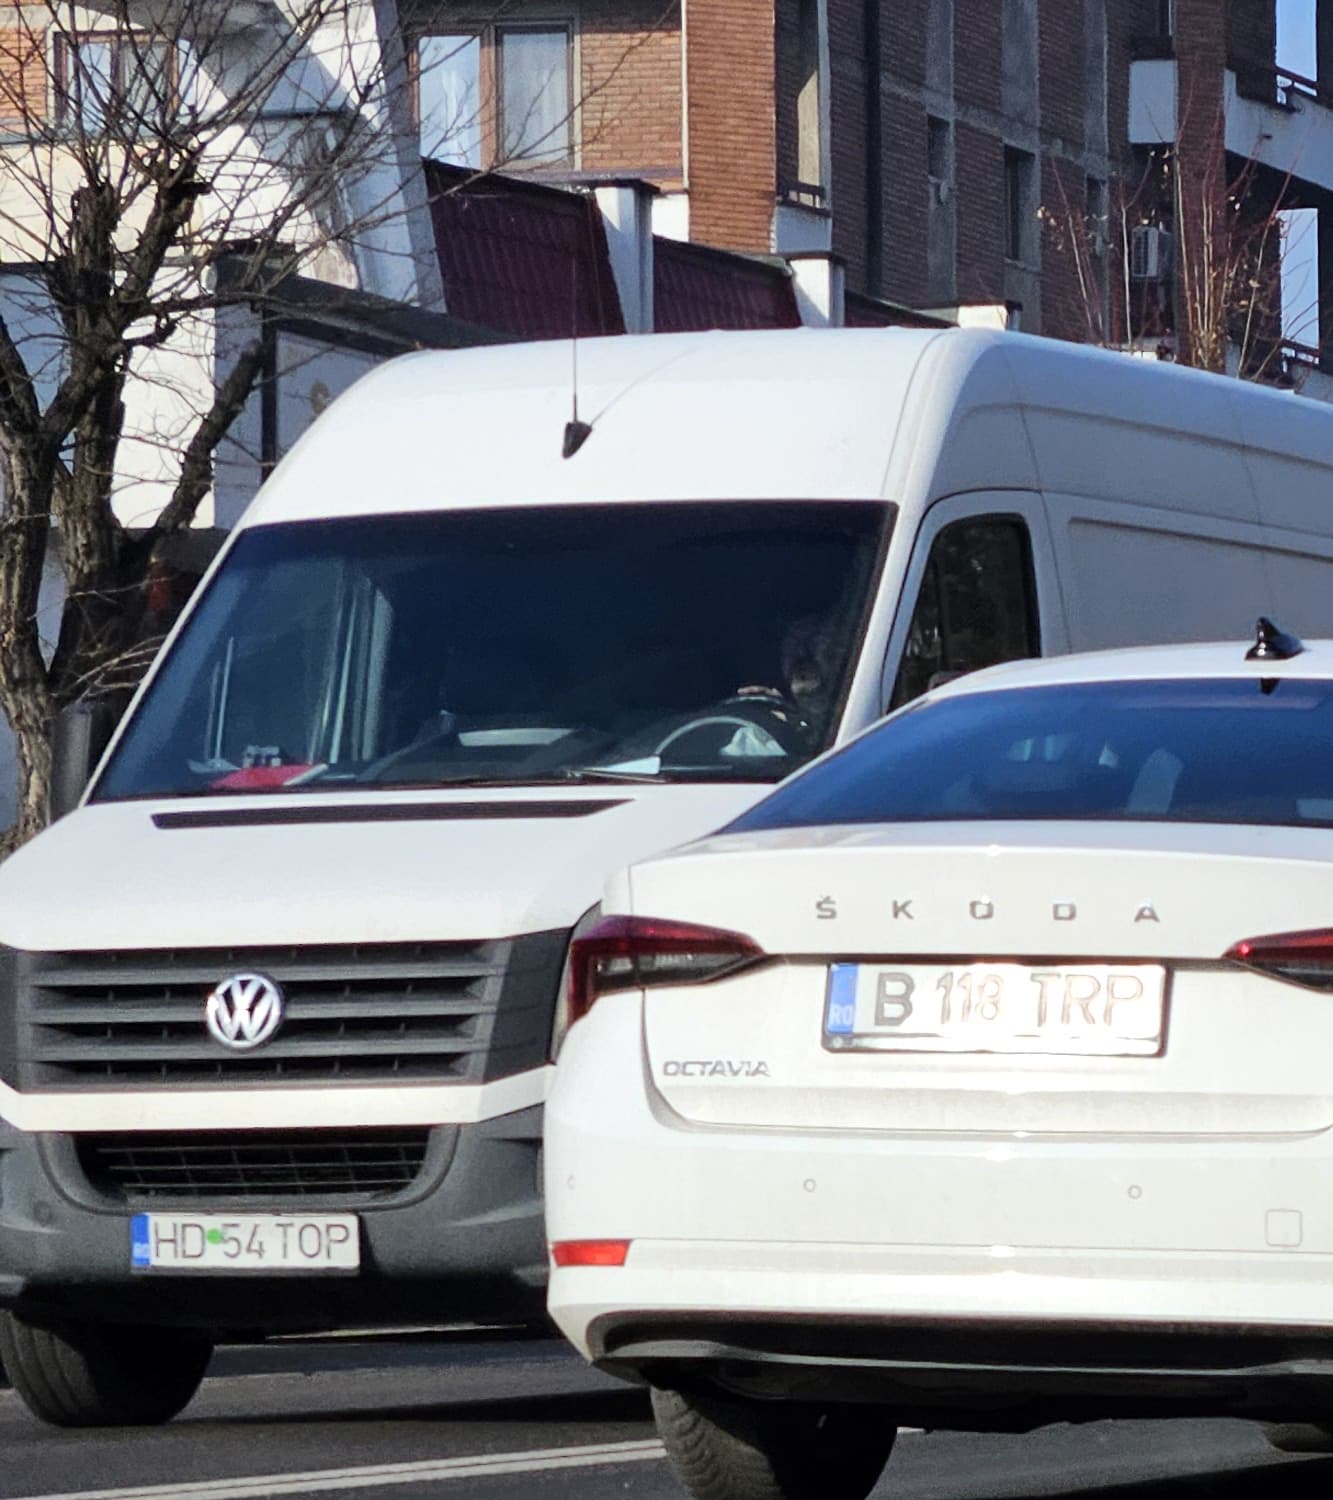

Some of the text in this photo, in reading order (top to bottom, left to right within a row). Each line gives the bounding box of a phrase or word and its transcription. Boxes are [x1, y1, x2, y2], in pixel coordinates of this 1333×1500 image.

[815, 895, 1161, 923] ŠKODA
[874, 972, 915, 1027] B
[936, 971, 1005, 1026] 118
[1030, 973, 1144, 1028] TRP
[662, 1059, 772, 1077] OCTAVIA
[154, 1222, 206, 1259] HD
[220, 1222, 265, 1259] 54
[275, 1222, 350, 1259] TOP
